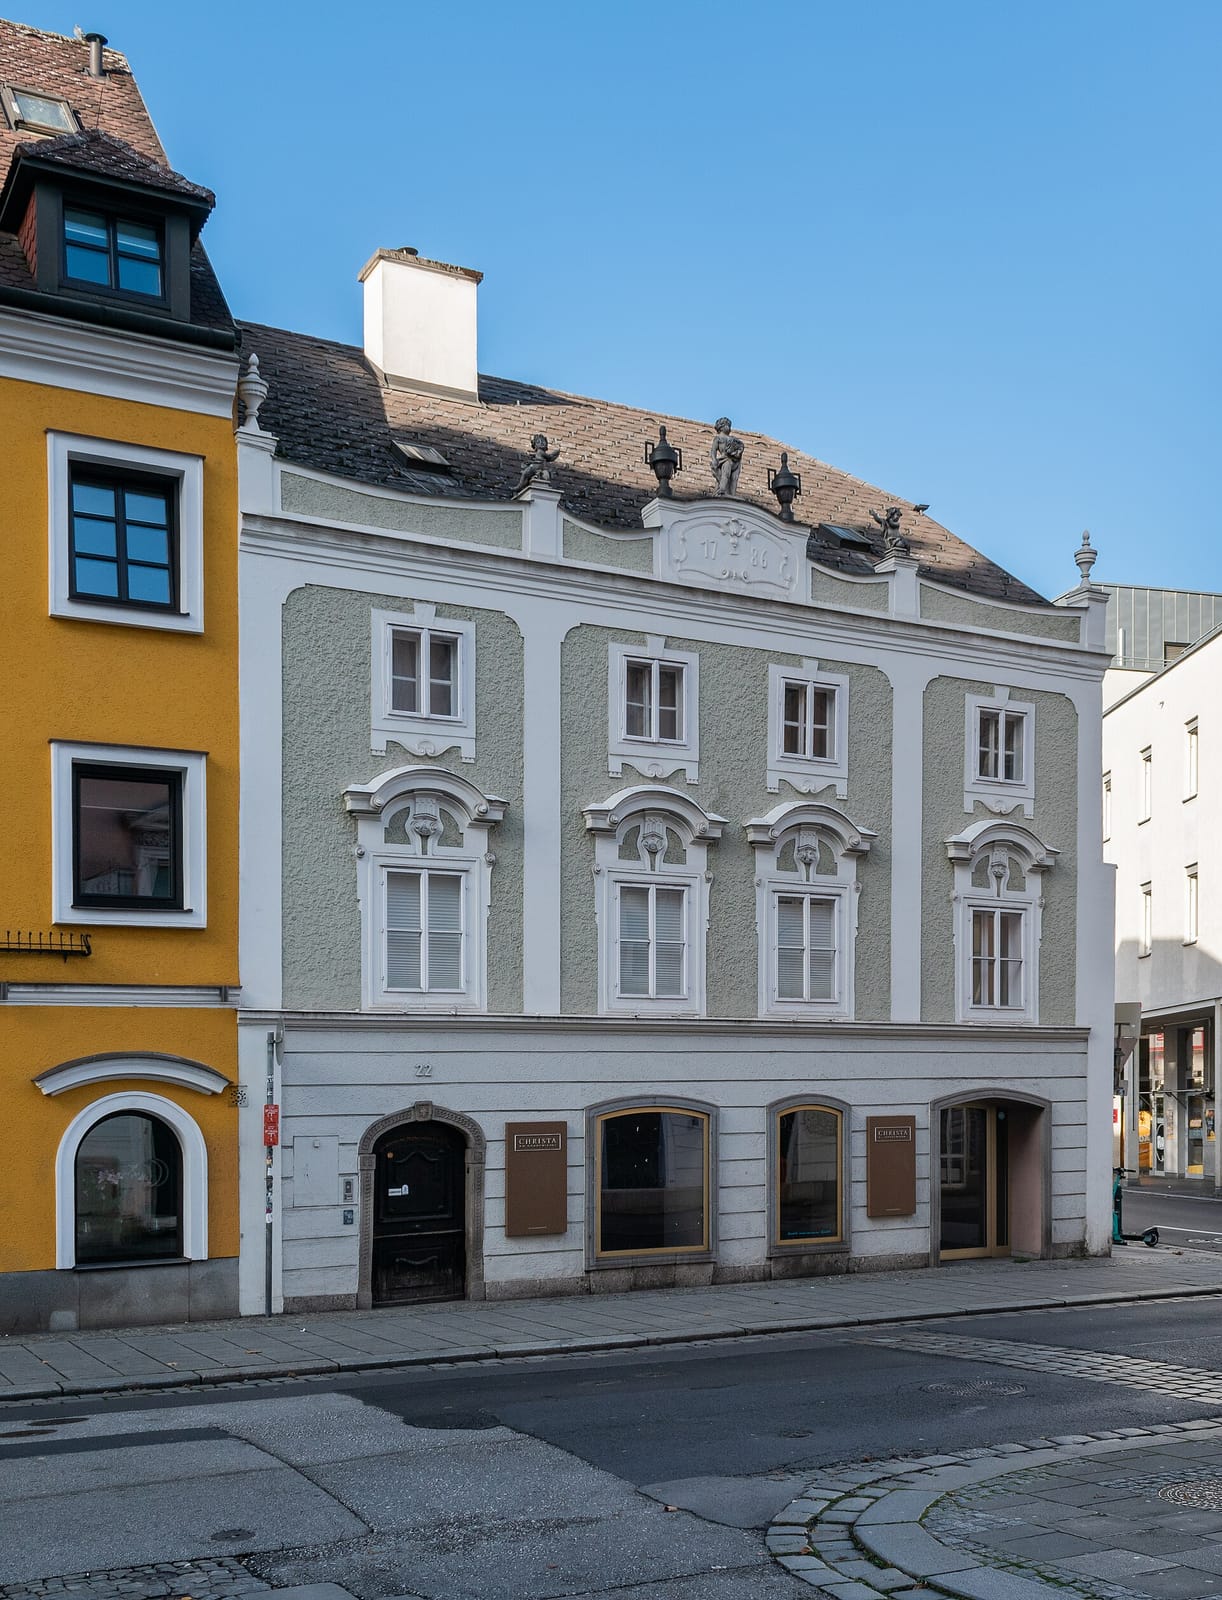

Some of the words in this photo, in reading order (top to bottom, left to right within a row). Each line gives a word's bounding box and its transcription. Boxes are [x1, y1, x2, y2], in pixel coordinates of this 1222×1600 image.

[700, 540, 717, 560] 17
[751, 548, 768, 569] 86
[415, 1063, 432, 1077] 22
[518, 1137, 557, 1145] CHRISTA
